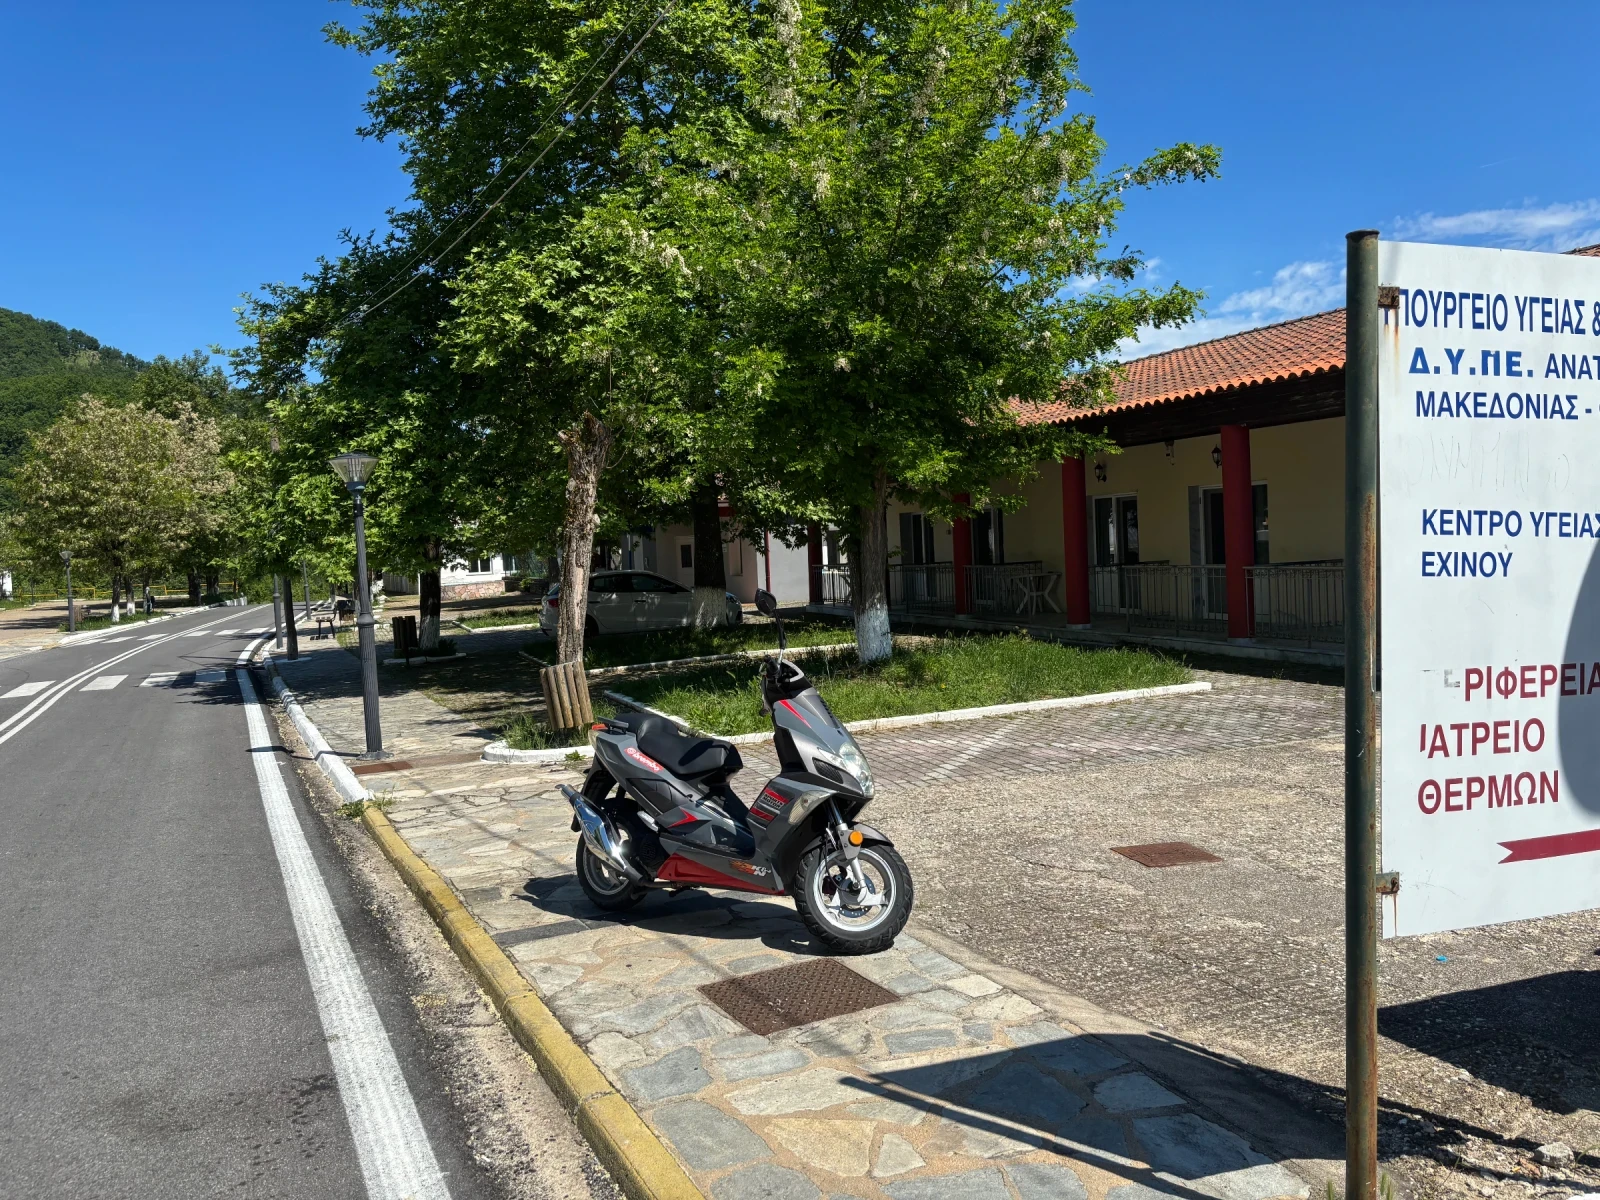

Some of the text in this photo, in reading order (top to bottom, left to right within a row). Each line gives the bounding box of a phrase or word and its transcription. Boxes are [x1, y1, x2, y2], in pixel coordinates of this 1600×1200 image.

[1514, 295, 1586, 335] ΥΓΕΙΑΣ
[1415, 390, 1579, 420] ΜΑΚΕΔΟΝΙΑΣ
[1422, 509, 1523, 537] ΚΕΝΤΡΟ
[1421, 551, 1513, 578] ΕΧΙΝΟΥ
[1419, 717, 1546, 759] ΙΑΤΡΕΙΟ
[1417, 769, 1559, 815] ΘΕΡΜΩΝ
